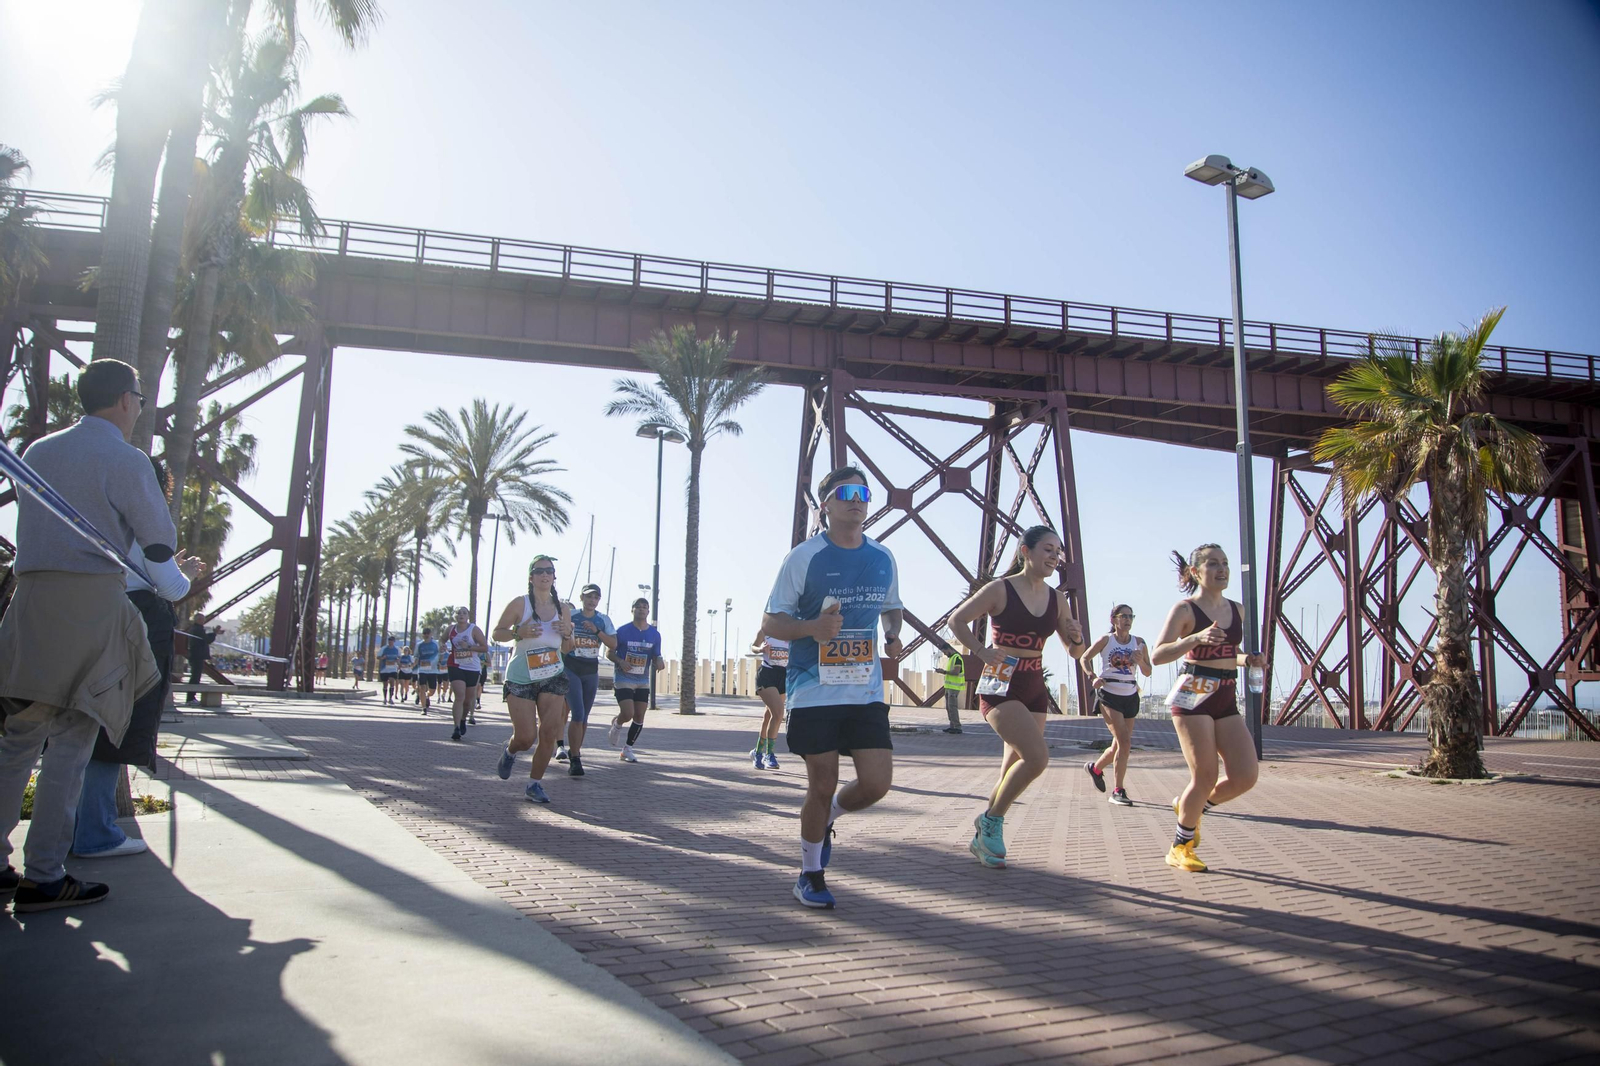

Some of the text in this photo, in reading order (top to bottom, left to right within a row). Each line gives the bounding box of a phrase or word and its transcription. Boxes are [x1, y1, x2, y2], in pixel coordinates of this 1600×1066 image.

[836, 592, 886, 604] lmería 2025
[826, 640, 869, 657] 2053
[1186, 644, 1233, 660] NIKE
[537, 652, 551, 664] 74
[1018, 657, 1042, 672] IKE
[1182, 673, 1215, 693] 215
